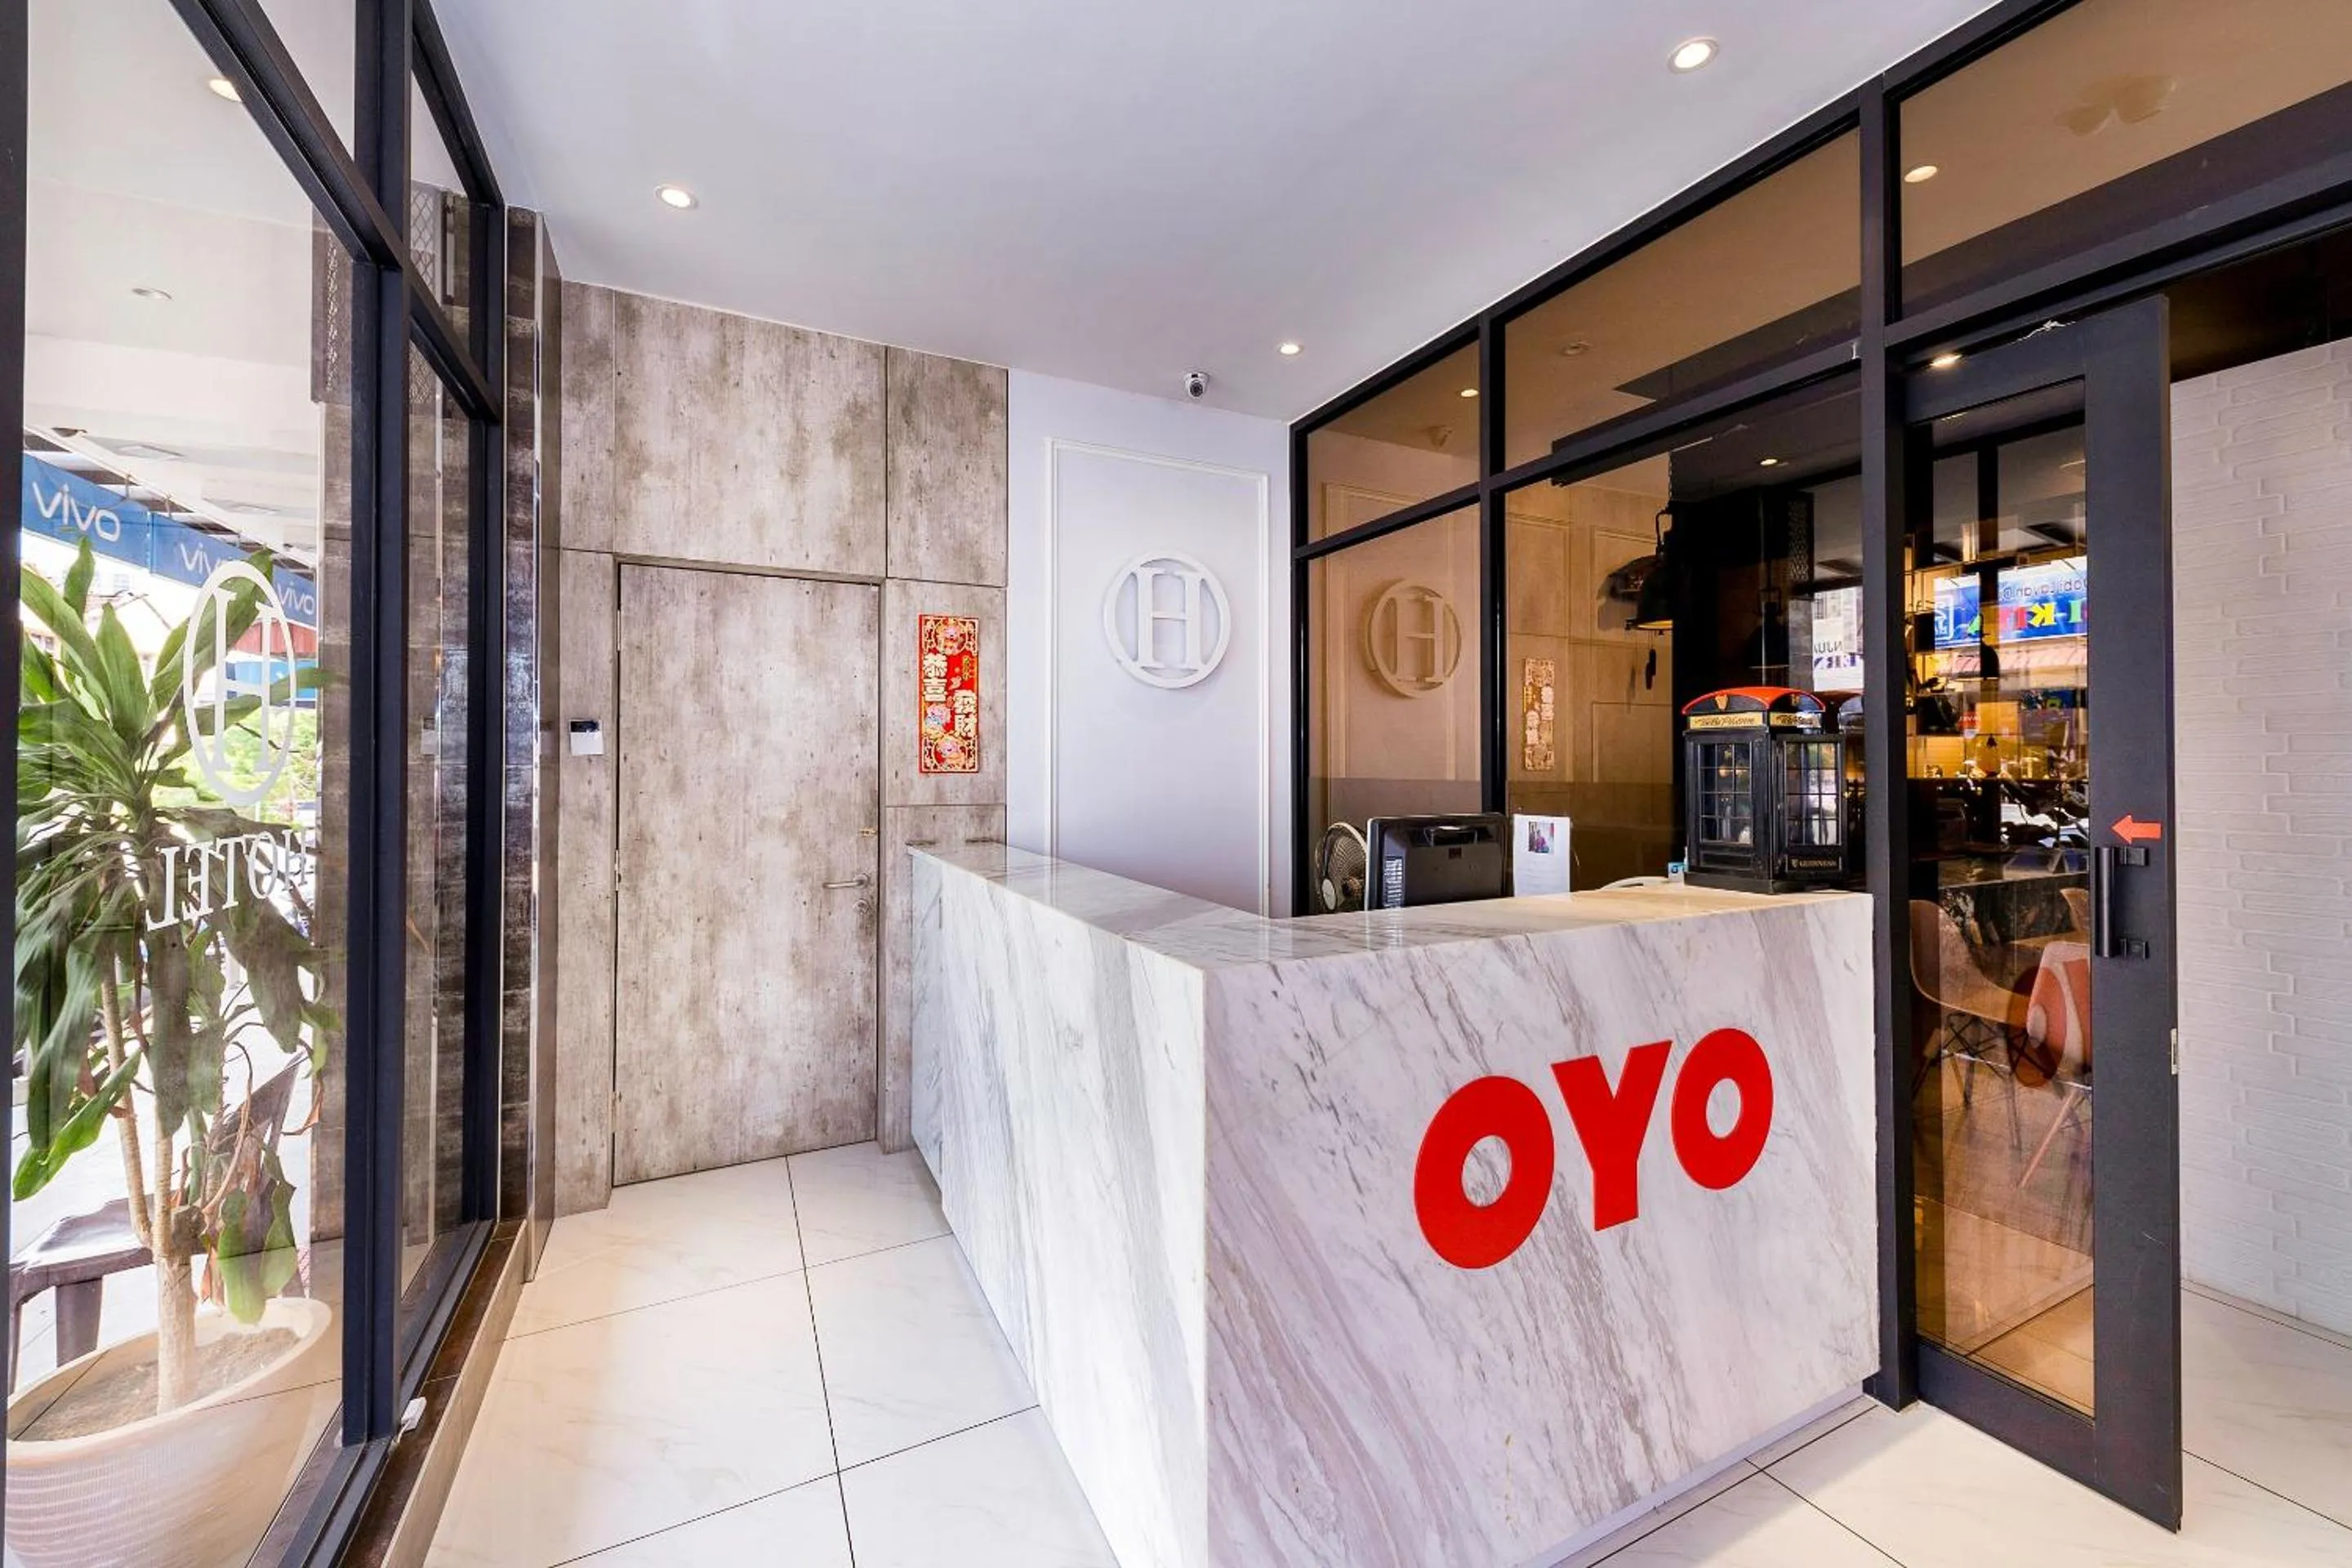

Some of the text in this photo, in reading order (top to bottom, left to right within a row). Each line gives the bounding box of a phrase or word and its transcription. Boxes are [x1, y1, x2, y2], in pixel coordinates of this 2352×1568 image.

[32, 481, 121, 542] vivo
[180, 541, 222, 576] viv
[277, 581, 315, 616] vivo
[1414, 1027, 1774, 1269] OYO
